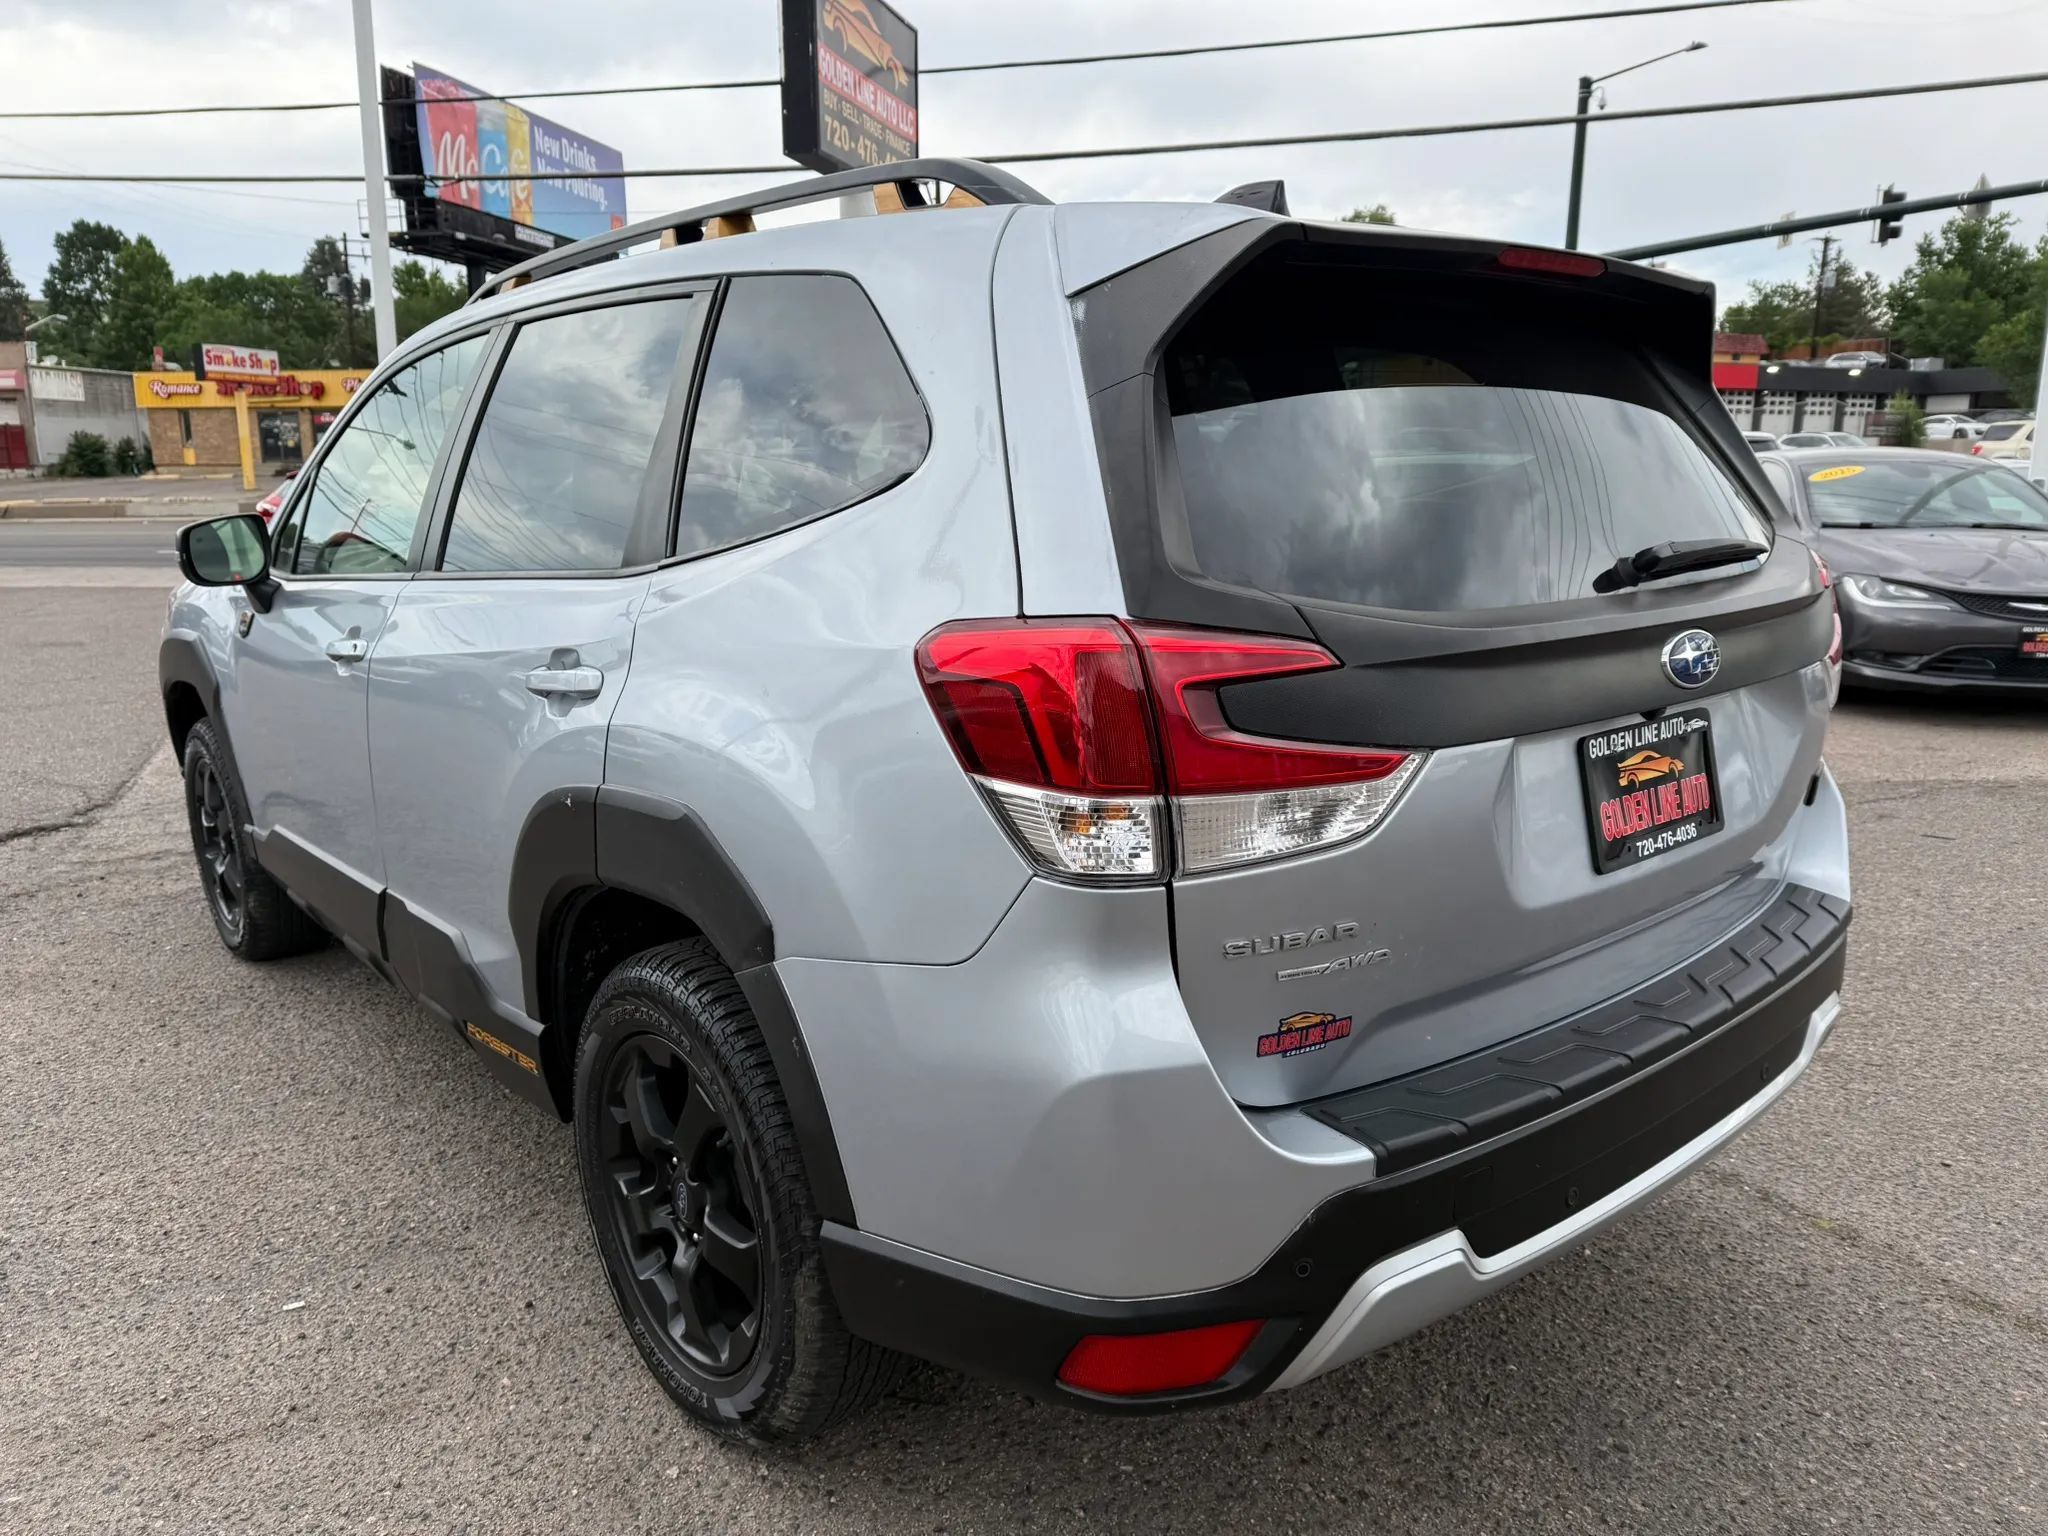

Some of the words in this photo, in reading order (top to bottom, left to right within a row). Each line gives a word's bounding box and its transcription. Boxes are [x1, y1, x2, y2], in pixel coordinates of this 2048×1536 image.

[819, 47, 855, 97] GOLDEN
[856, 73, 875, 111] LINE
[876, 89, 897, 125] AUTO
[898, 105, 914, 136] LLC
[534, 125, 560, 160] New
[149, 380, 201, 398] Romance
[1589, 730, 1633, 759] GOLDEN
[1635, 723, 1659, 747] LINE
[1660, 716, 1684, 739] AUTO
[1601, 789, 1652, 842] GOLDEN
[1650, 781, 1682, 825] LINE
[1681, 773, 1710, 817] AUTO
[1636, 822, 1697, 857] 720-476-4036
[1260, 1030, 1300, 1056] GOLDEN
[1301, 1024, 1325, 1046] LINE
[1324, 1018, 1351, 1041] AUTO
